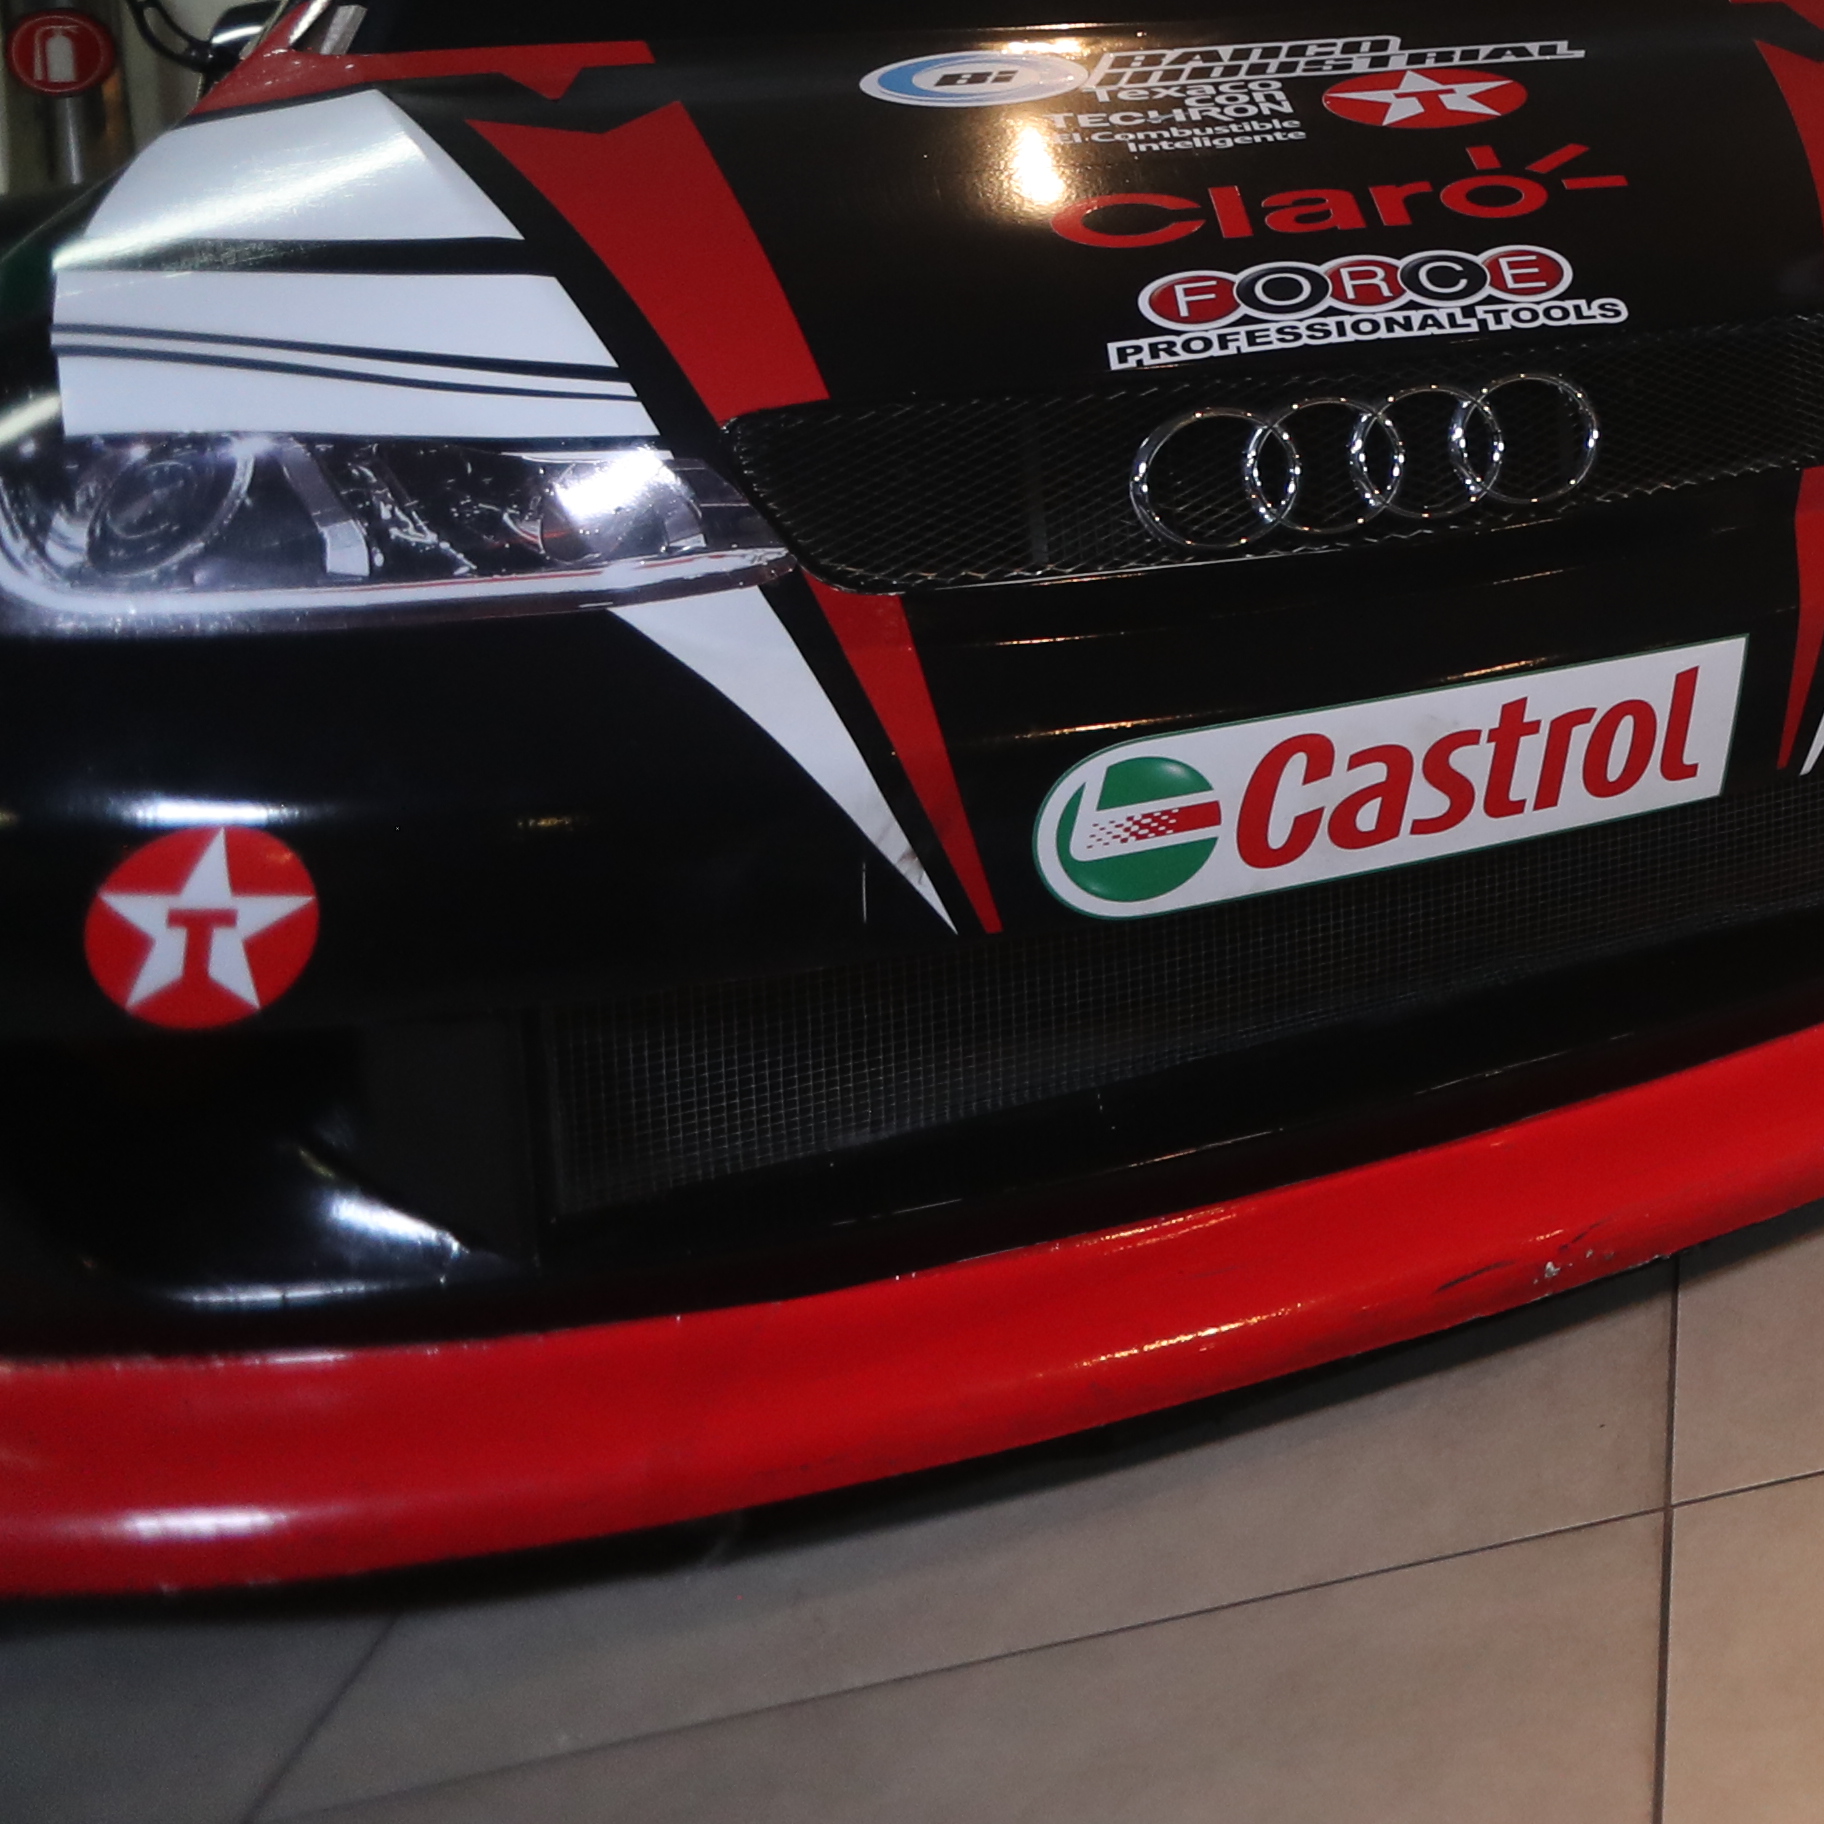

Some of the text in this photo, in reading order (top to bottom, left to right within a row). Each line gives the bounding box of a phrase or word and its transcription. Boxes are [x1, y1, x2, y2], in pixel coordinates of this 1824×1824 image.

[1095, 42, 1584, 88] INDUSTRIAL
[1108, 37, 1399, 69] BANCO
[1083, 80, 1282, 102] Texaco
[1184, 91, 1286, 107] con
[1049, 101, 1294, 128] TECHRON
[1091, 119, 1301, 142] Combustible
[1128, 130, 1307, 153] Inteligente
[1051, 176, 1548, 249] Claro
[1175, 253, 1547, 318] FORCE
[1116, 302, 1621, 365] PROFESSIONAL TOOLS
[1236, 666, 1700, 869] Castrol
